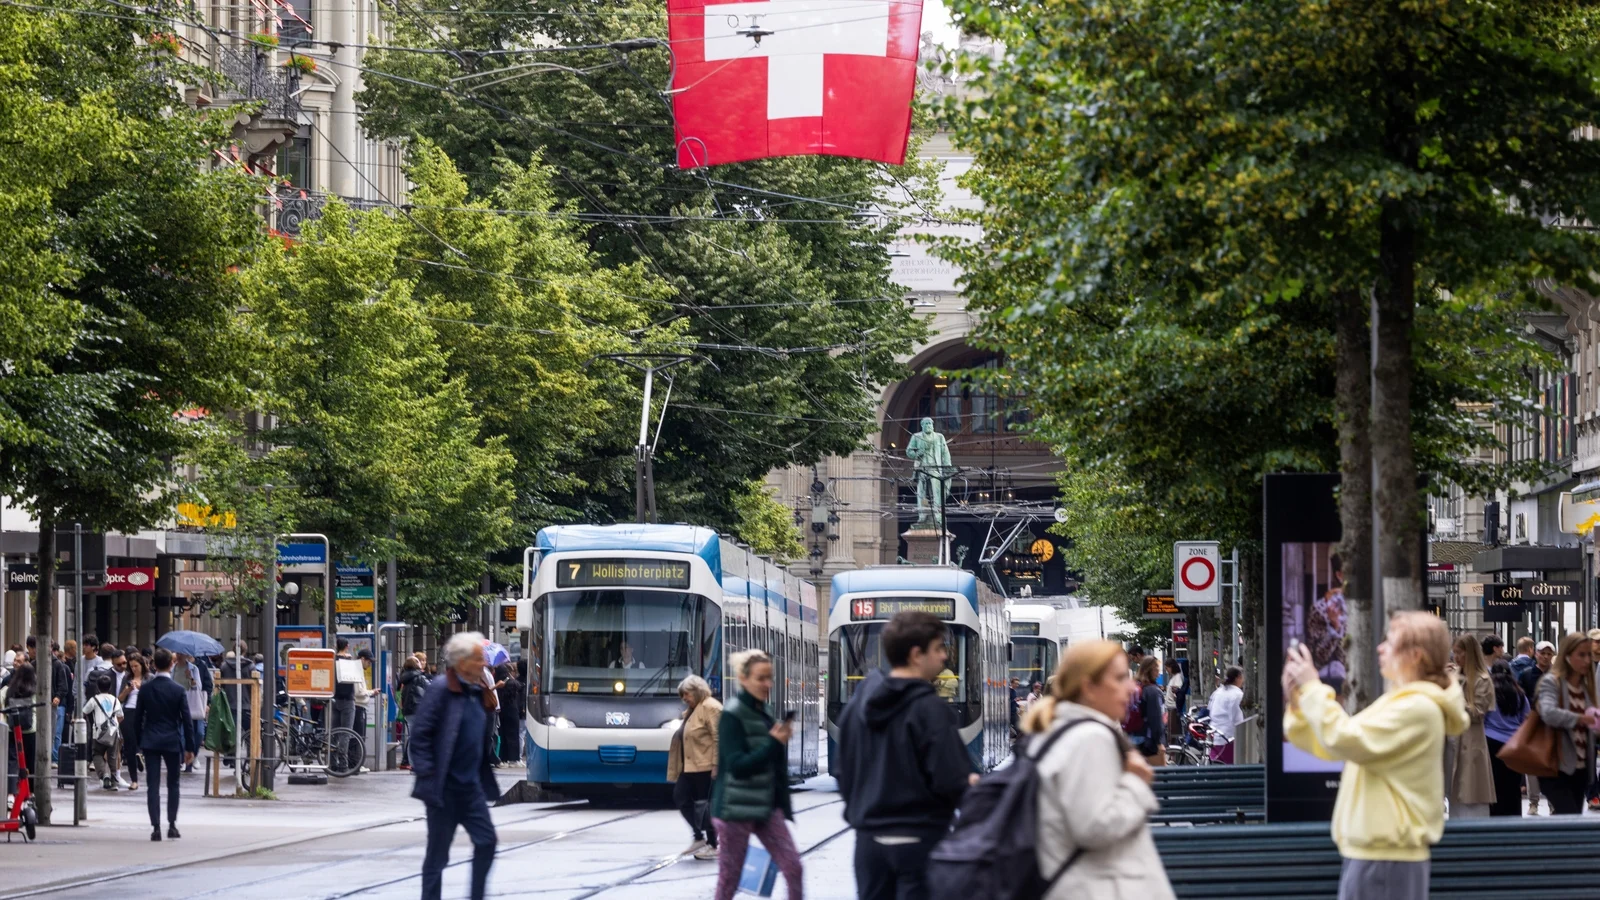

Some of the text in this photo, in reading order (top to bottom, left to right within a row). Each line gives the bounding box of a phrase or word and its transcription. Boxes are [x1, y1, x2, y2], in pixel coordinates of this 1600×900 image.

[1188, 548, 1208, 556] ZONE
[568, 563, 685, 580] 7 Wollishoferplatz
[1501, 586, 1524, 599] GÖT
[1531, 583, 1572, 596] GÖTTE
[855, 601, 873, 615] 15
[879, 602, 896, 614] Bhf.
